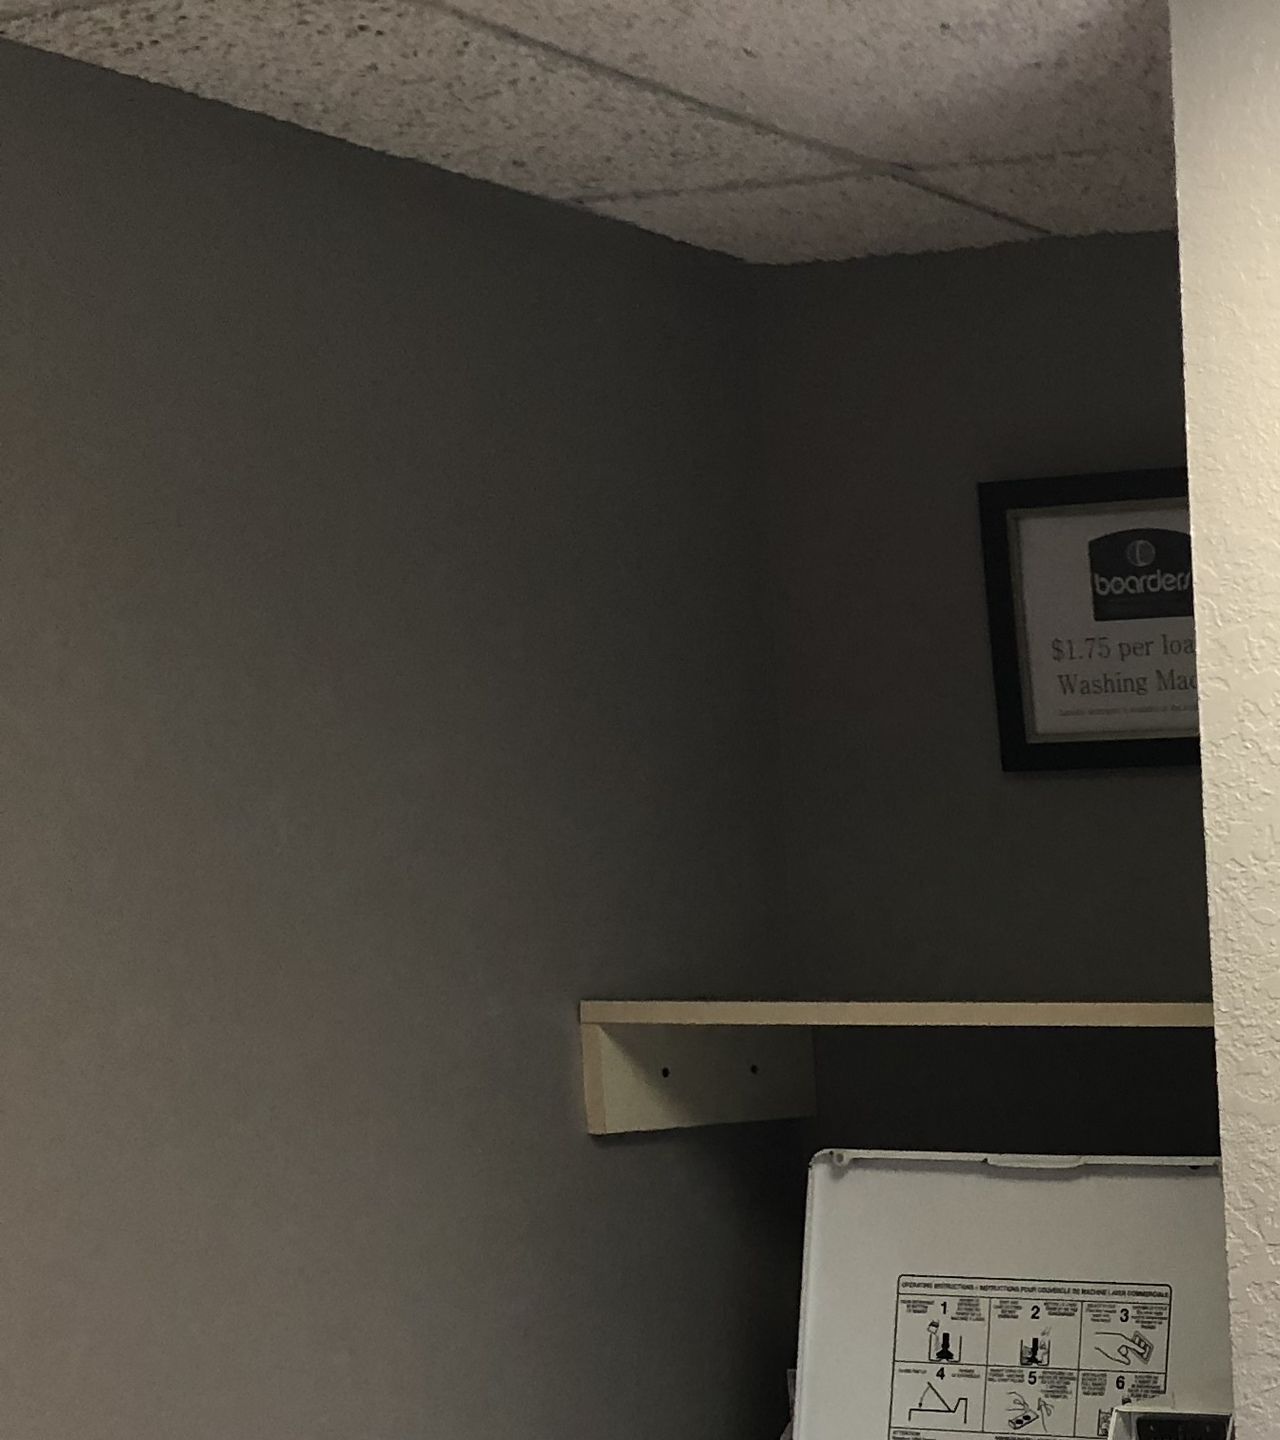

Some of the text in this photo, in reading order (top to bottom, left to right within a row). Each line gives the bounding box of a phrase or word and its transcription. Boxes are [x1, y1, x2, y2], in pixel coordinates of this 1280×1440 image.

[1093, 569, 1191, 596] boarders
[1051, 636, 1111, 663] $1.75
[1118, 640, 1155, 662] per
[1057, 671, 1148, 697] Washing
[940, 1301, 948, 1315] 1
[1030, 1305, 1040, 1320] 2
[1119, 1308, 1129, 1322] 3
[935, 1367, 946, 1380] 4
[1027, 1371, 1037, 1385] 5
[1115, 1375, 1125, 1390] 6
